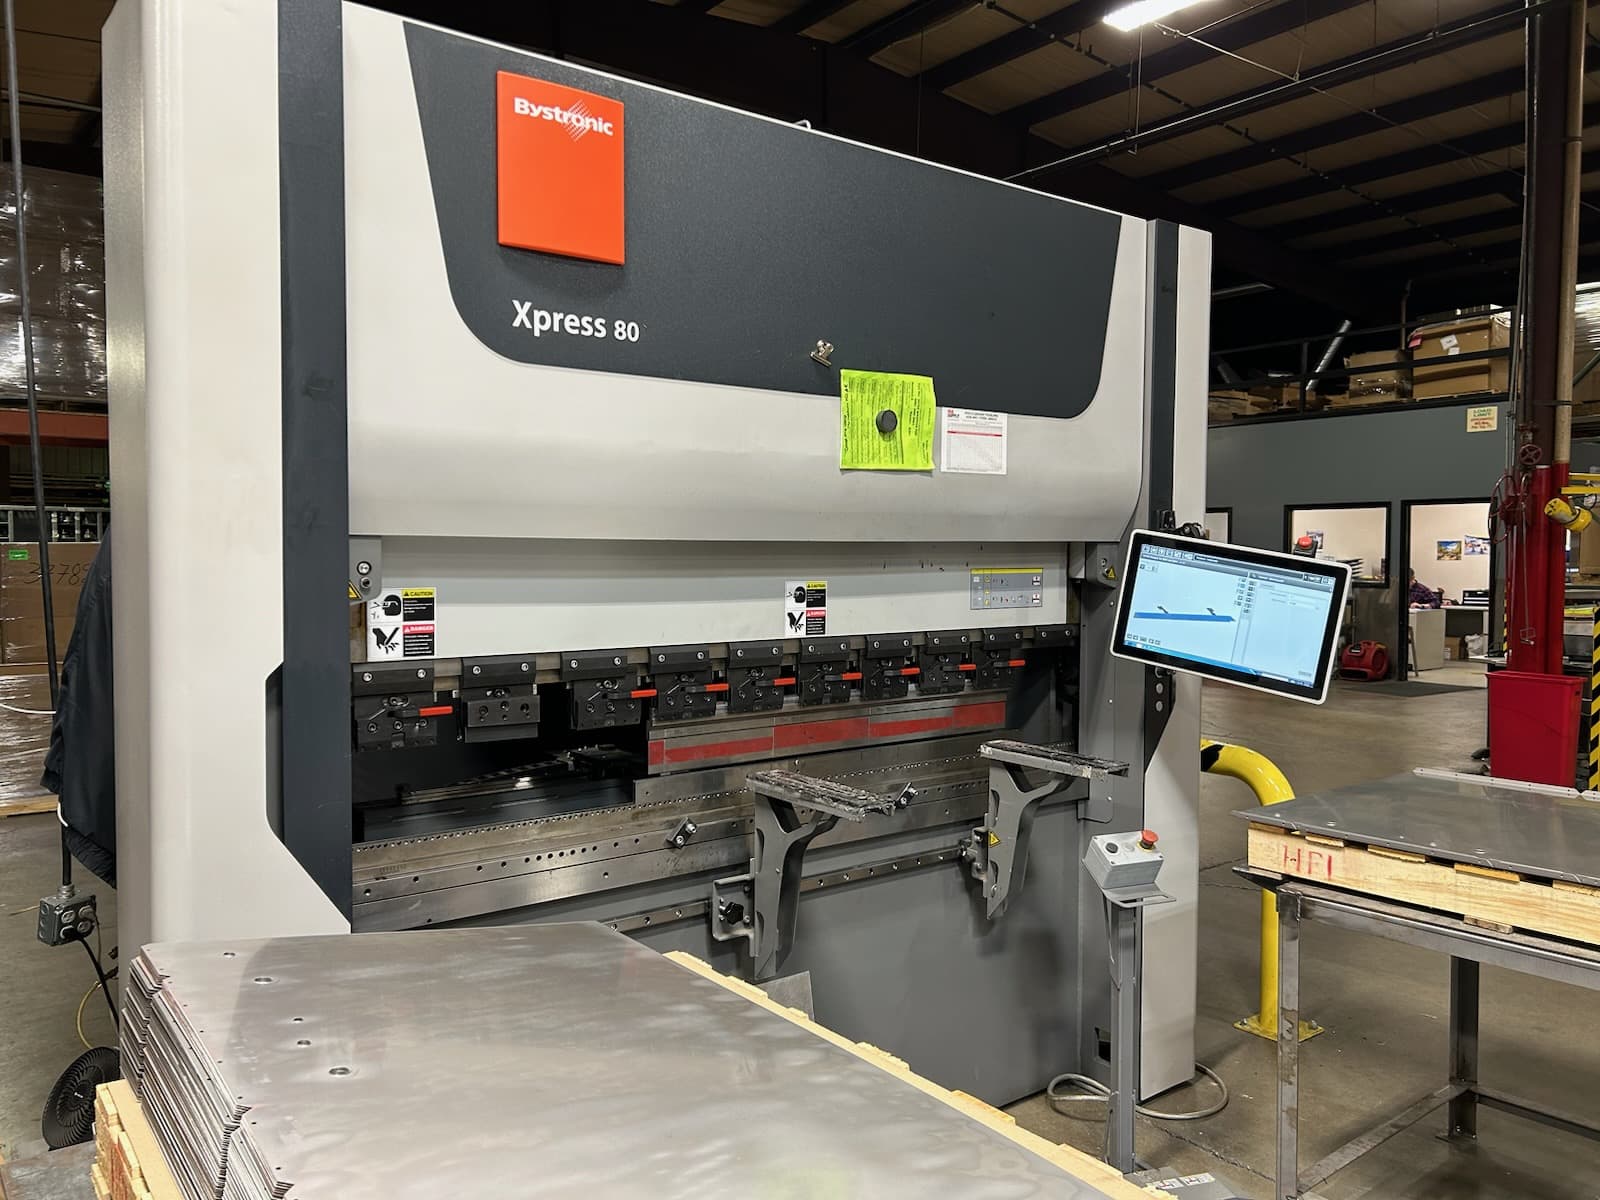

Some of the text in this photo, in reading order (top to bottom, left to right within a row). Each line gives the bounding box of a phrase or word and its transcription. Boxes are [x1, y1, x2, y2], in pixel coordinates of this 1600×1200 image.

[514, 97, 613, 136] Bystronic
[512, 300, 640, 342] Xpress 80
